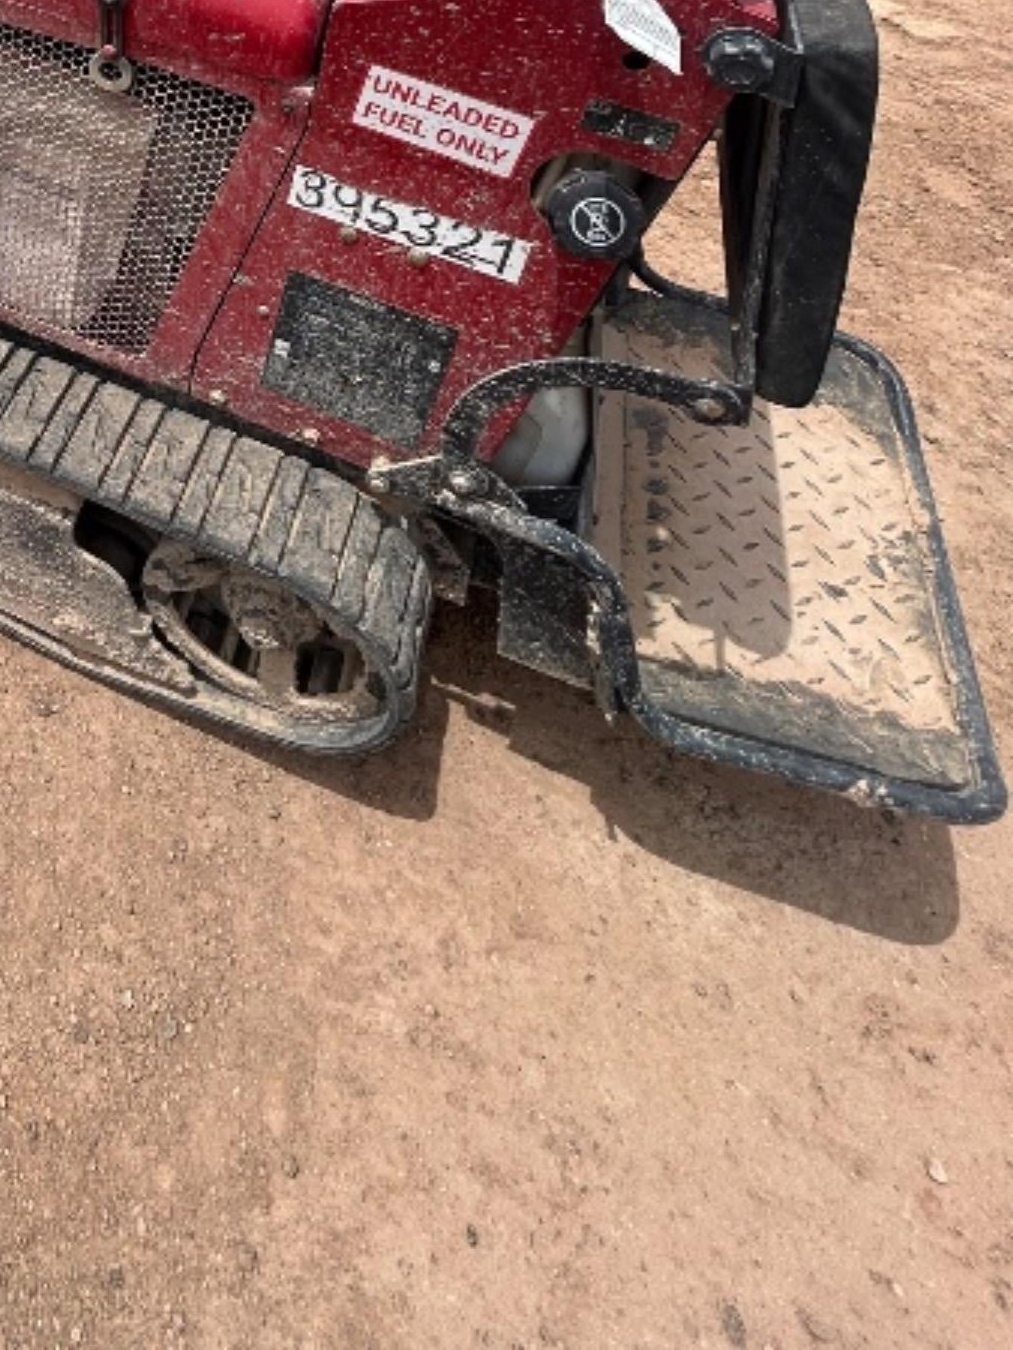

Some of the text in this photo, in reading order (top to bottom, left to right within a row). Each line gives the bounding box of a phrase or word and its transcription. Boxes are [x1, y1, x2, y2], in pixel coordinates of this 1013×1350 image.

[362, 101, 509, 165] FUEL ONLY
[373, 74, 520, 139] UNLEADED
[295, 170, 515, 275] 395321
